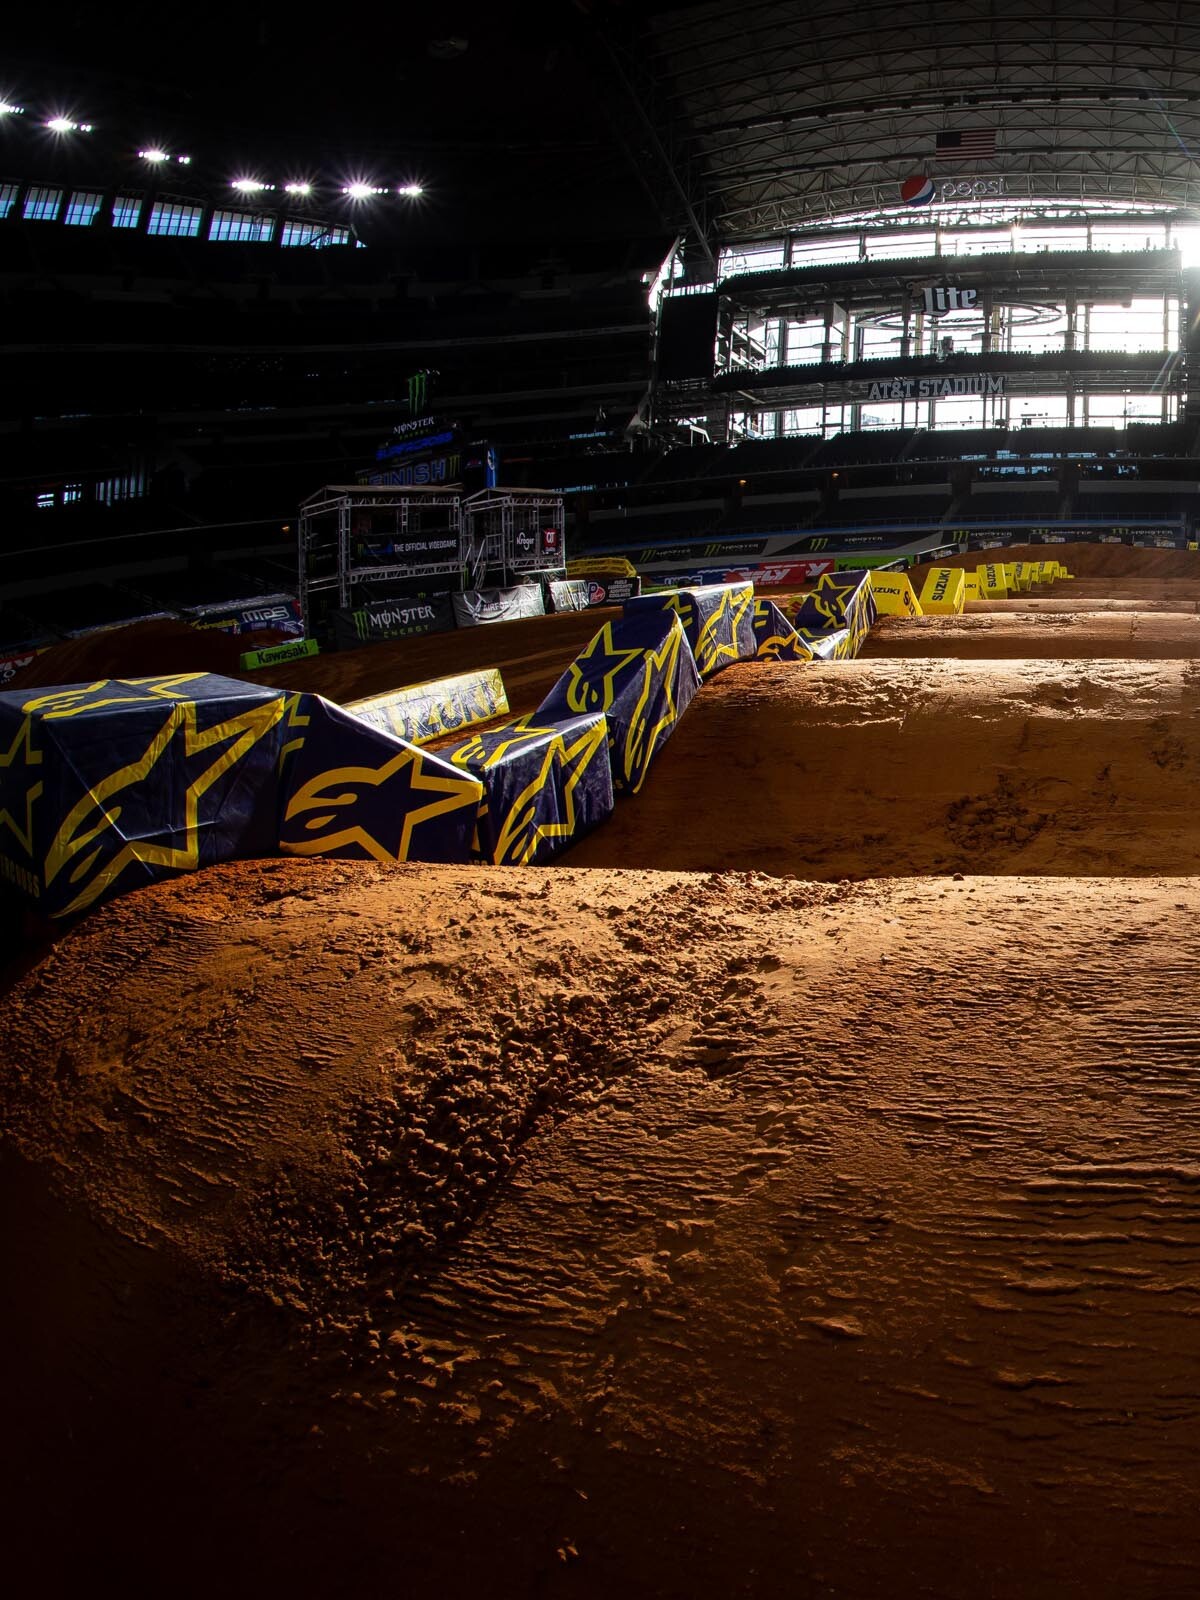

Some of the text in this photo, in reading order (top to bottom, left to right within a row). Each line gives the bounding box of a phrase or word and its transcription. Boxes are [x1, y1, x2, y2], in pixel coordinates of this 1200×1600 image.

[940, 177, 1005, 203] pepsi
[921, 287, 978, 317] Lite
[868, 376, 1006, 400] AT&T STADIUM
[516, 532, 535, 551] Kroger
[931, 569, 952, 601] SUZUKI
[256, 642, 309, 664] Kawasaki
